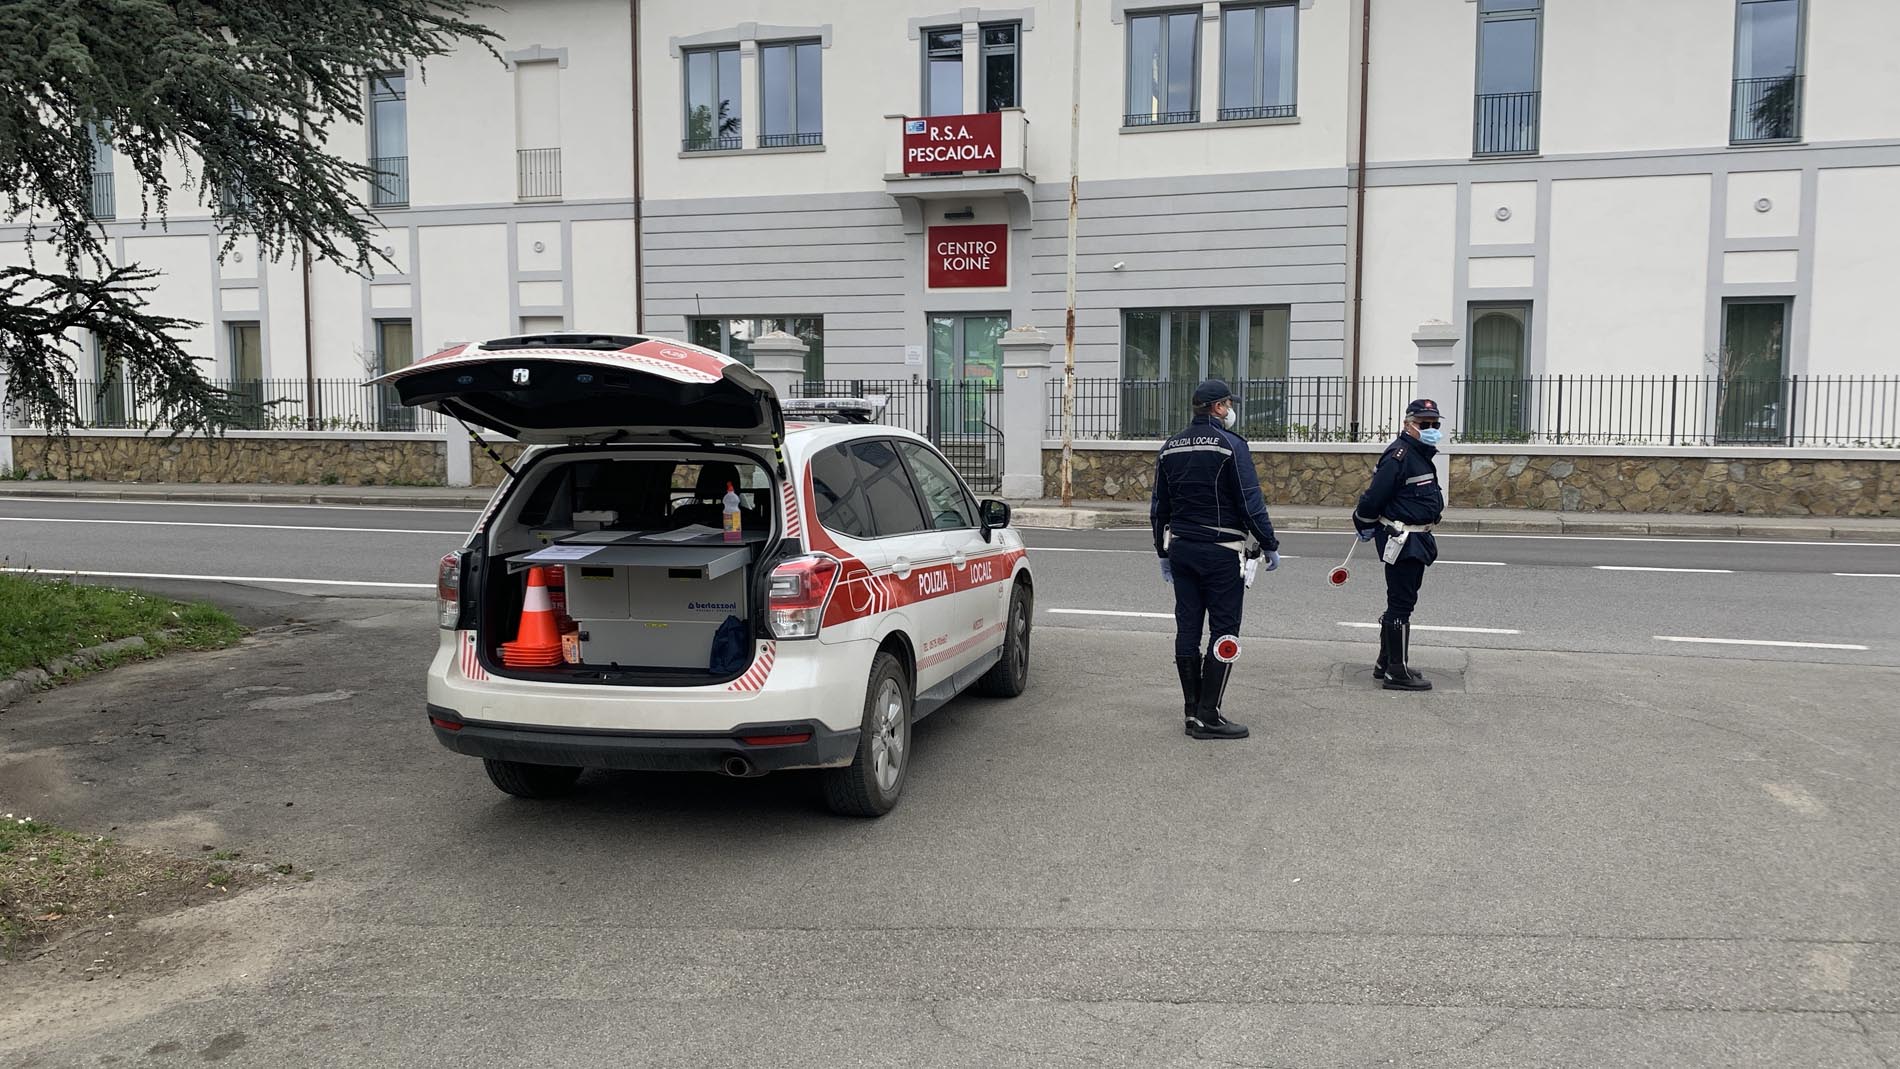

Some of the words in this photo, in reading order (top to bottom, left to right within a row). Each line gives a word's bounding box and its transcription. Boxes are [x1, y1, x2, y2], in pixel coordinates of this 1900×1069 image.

[930, 126, 974, 141] R.S.A.
[909, 144, 995, 162] PESCAIOLA
[937, 241, 997, 256] CENTRO
[943, 254, 991, 271] KOINÈ
[1169, 439, 1190, 448] POLIZIA
[1193, 437, 1219, 445] LOCALE
[919, 570, 948, 595] POLIZIA
[970, 562, 992, 584] LOCALE
